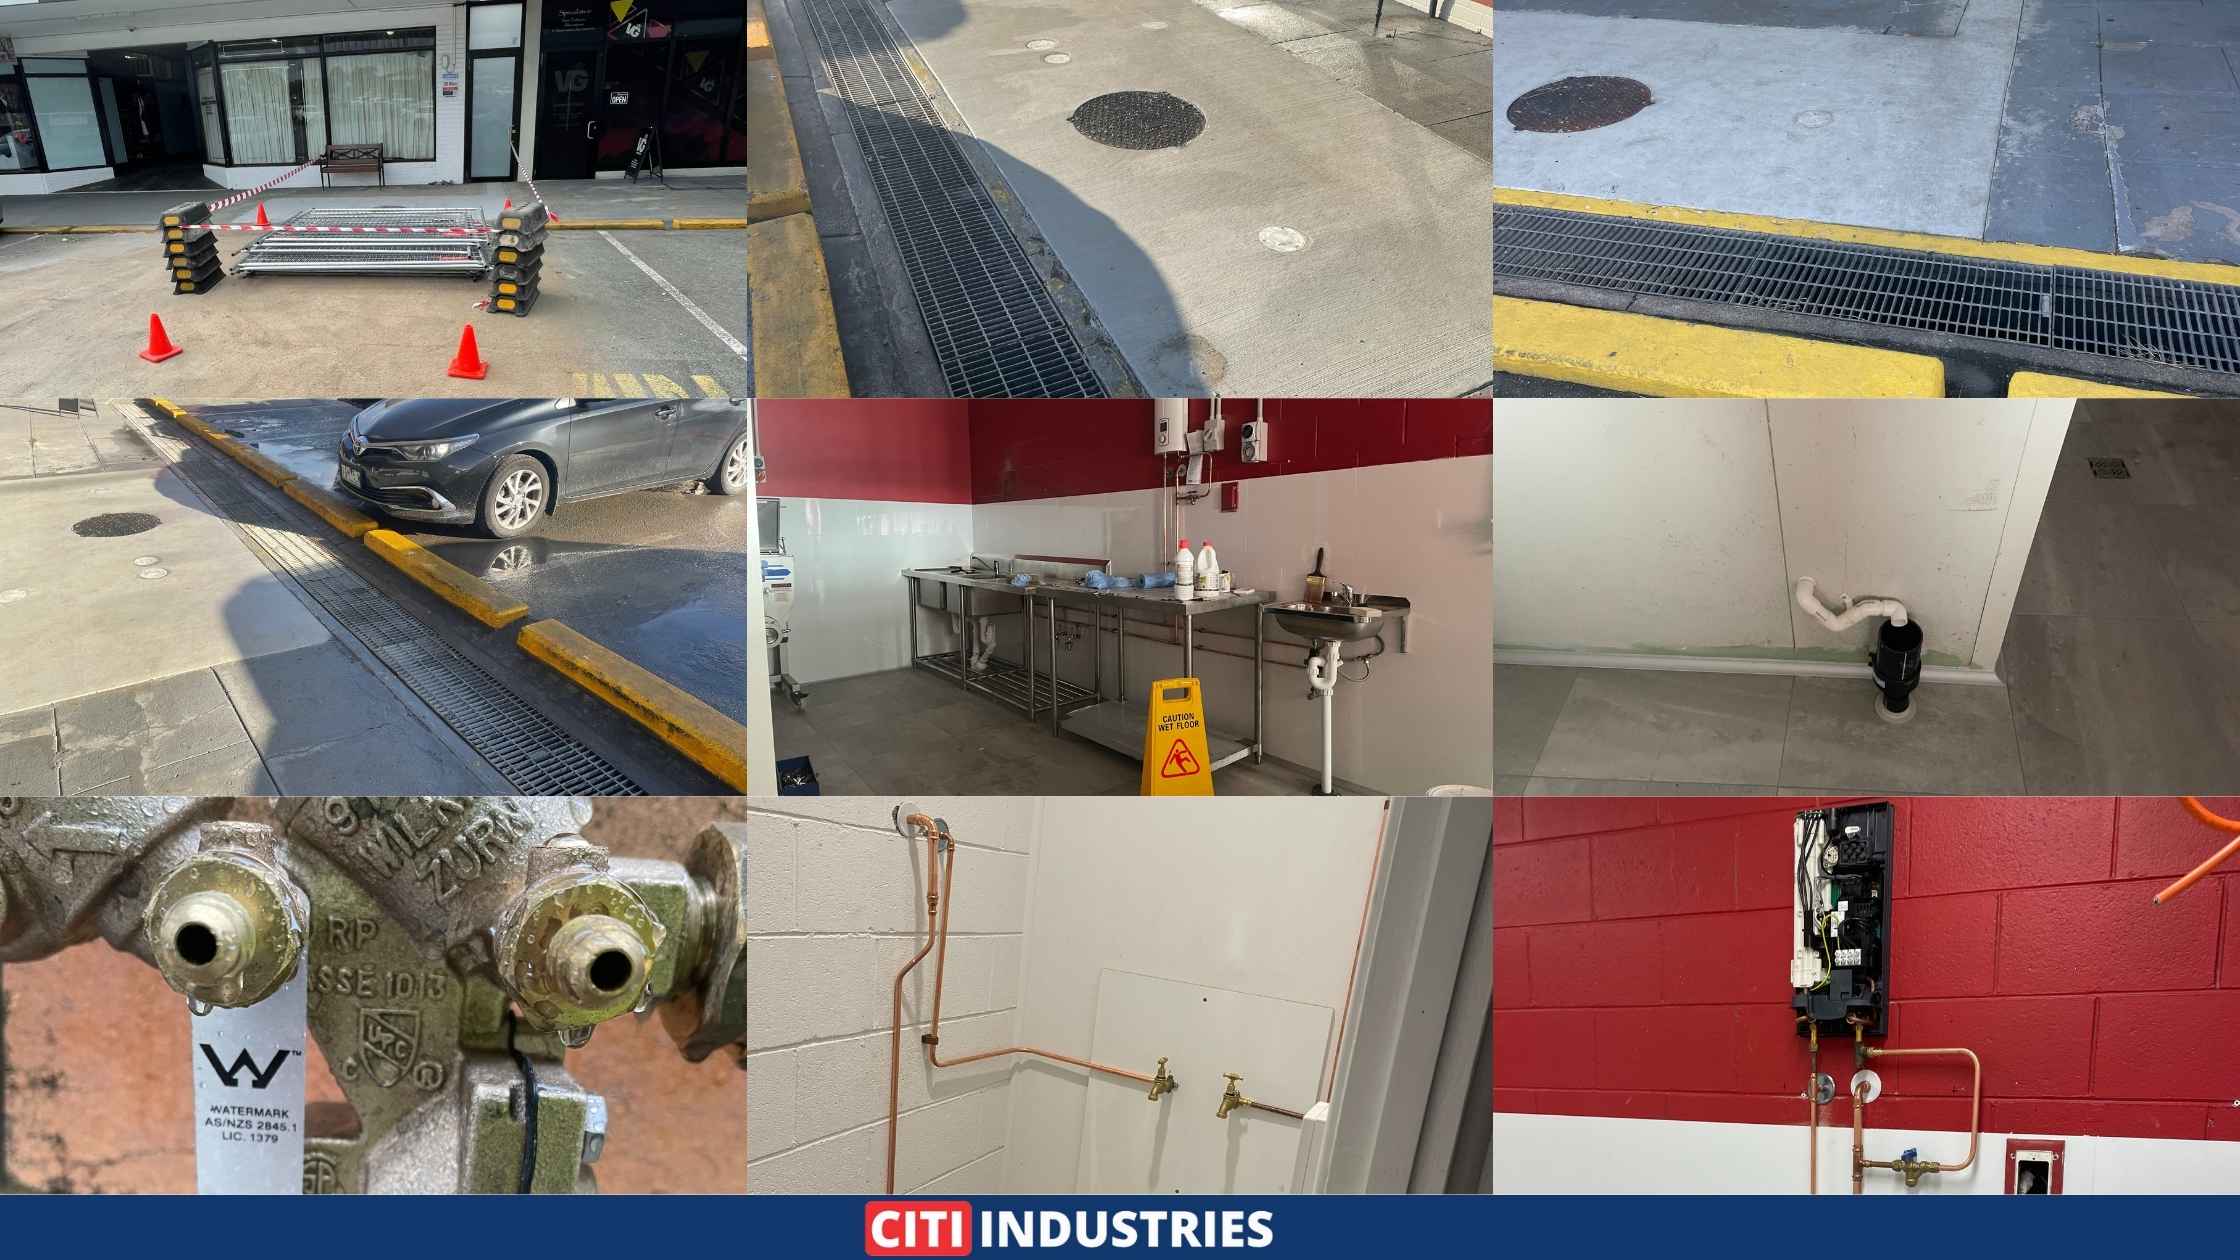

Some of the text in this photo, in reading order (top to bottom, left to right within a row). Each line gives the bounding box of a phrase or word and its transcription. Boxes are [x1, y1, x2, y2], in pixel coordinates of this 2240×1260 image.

[1162, 712, 1195, 723] CAUTION
[1158, 720, 1200, 732] WET FLOOR
[329, 915, 379, 950] RP
[308, 965, 448, 1000] SSE 1013
[209, 1104, 290, 1119] WATERMARK
[204, 1117, 297, 1133] AS/NZS 2845.1
[222, 1131, 279, 1144] LIC. 1379
